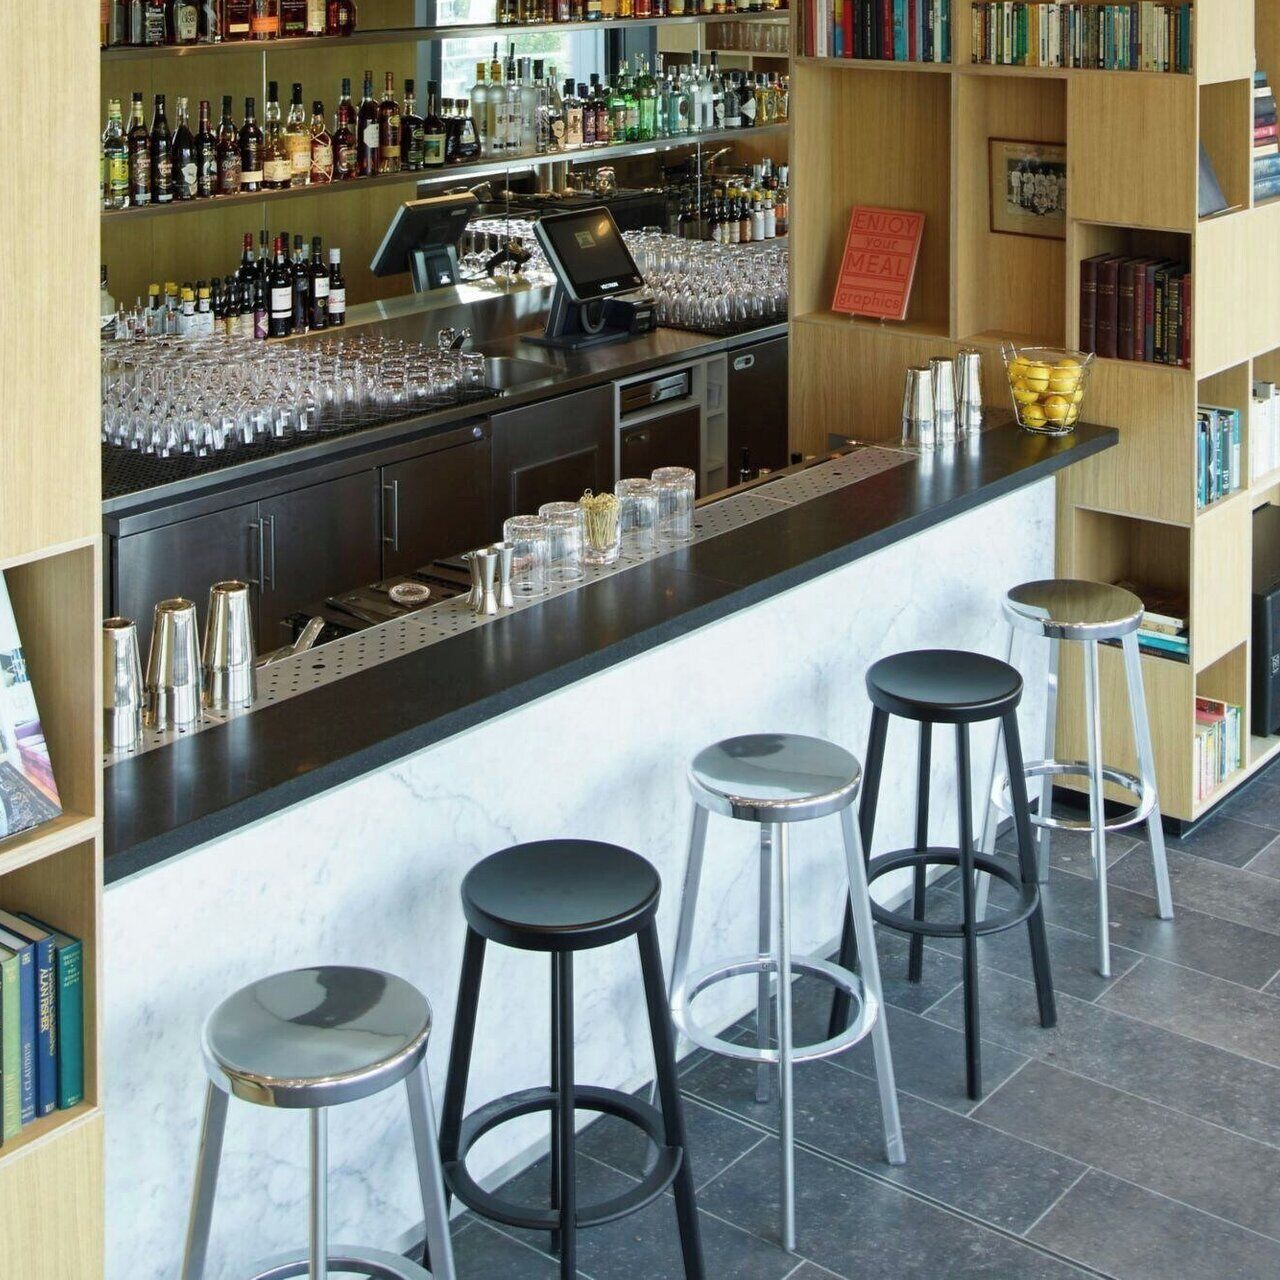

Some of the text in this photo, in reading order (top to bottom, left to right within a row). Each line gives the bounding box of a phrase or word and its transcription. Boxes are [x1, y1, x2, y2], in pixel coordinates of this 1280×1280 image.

[856, 213, 917, 235] ENJOY
[865, 238, 898, 249] your
[846, 251, 906, 277] MEAL
[840, 291, 900, 311] graphics
[39, 968, 50, 1032] ALAN FISHER
[24, 1043, 32, 1090] CLAUDIUS
